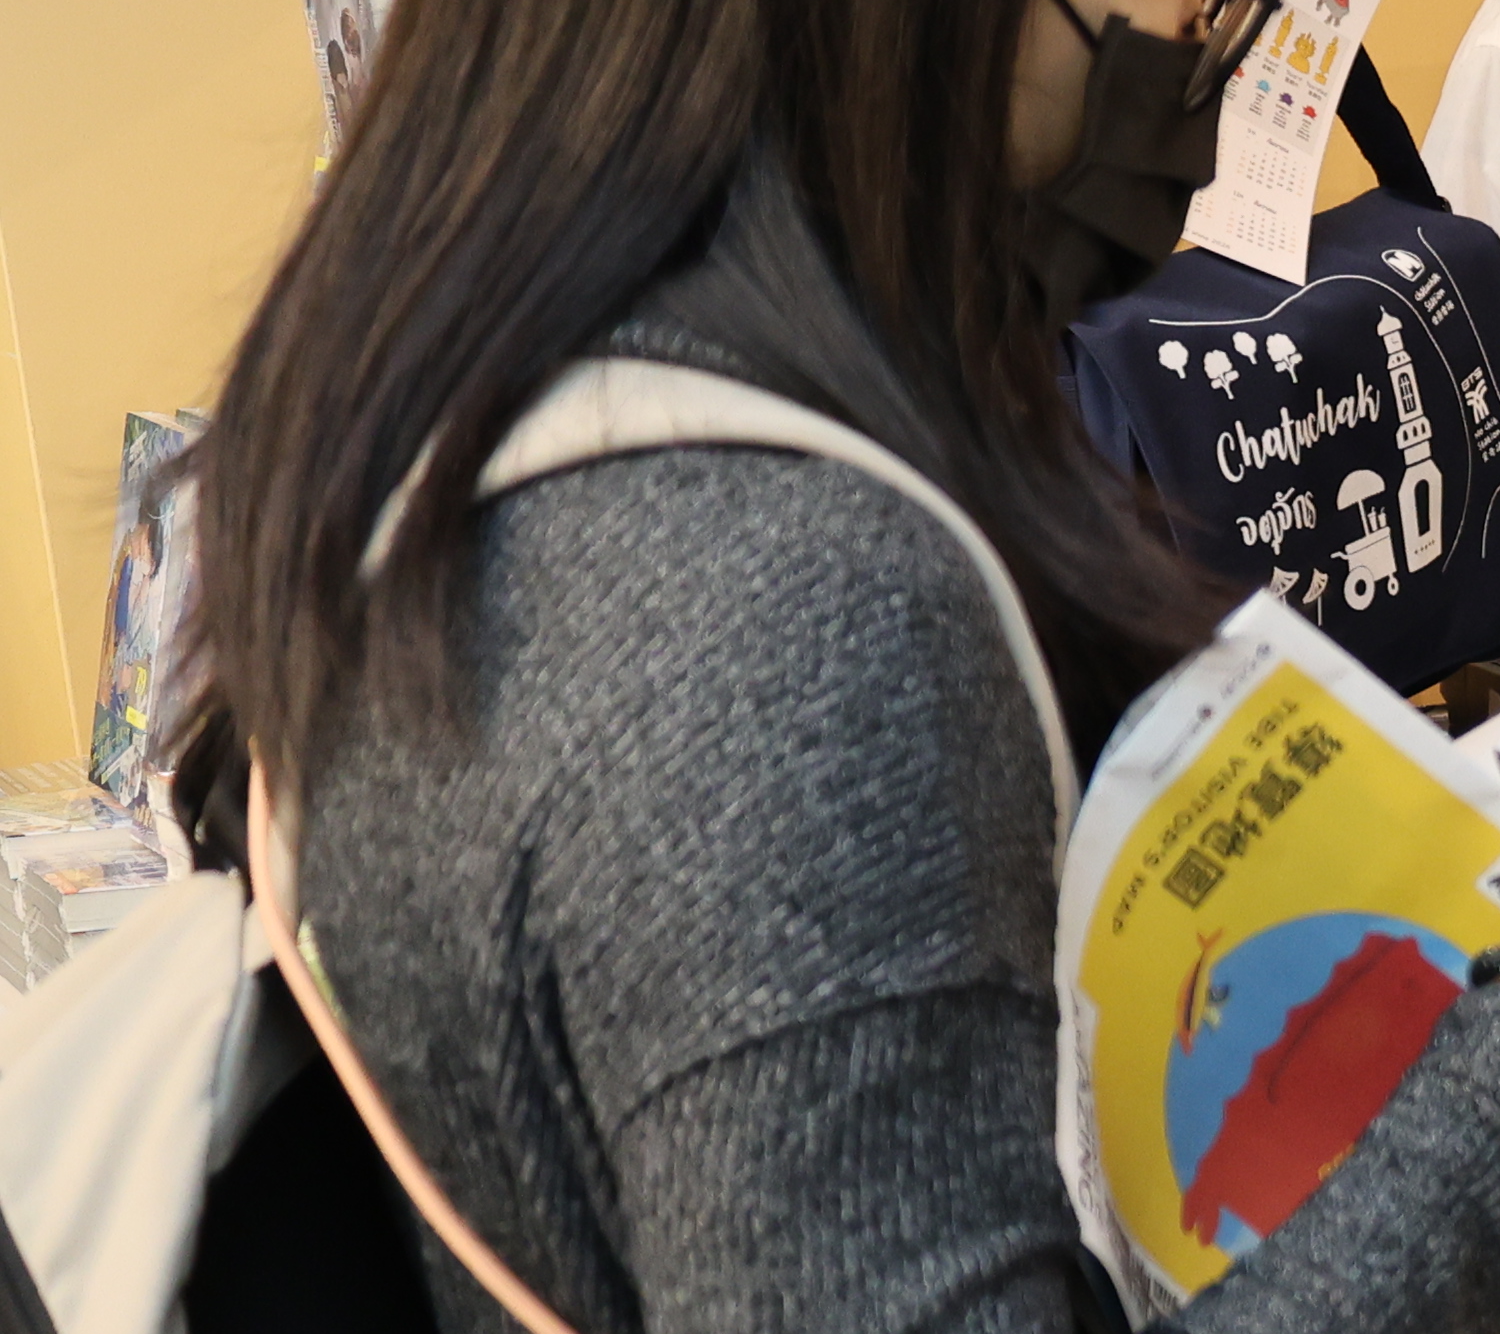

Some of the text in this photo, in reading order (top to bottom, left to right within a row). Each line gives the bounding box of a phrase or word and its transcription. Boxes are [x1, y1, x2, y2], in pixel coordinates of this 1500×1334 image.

[1216, 372, 1381, 483] Chatuchak
[1235, 487, 1318, 556] จตุจักร
[1160, 721, 1345, 910] 導覽地圖
